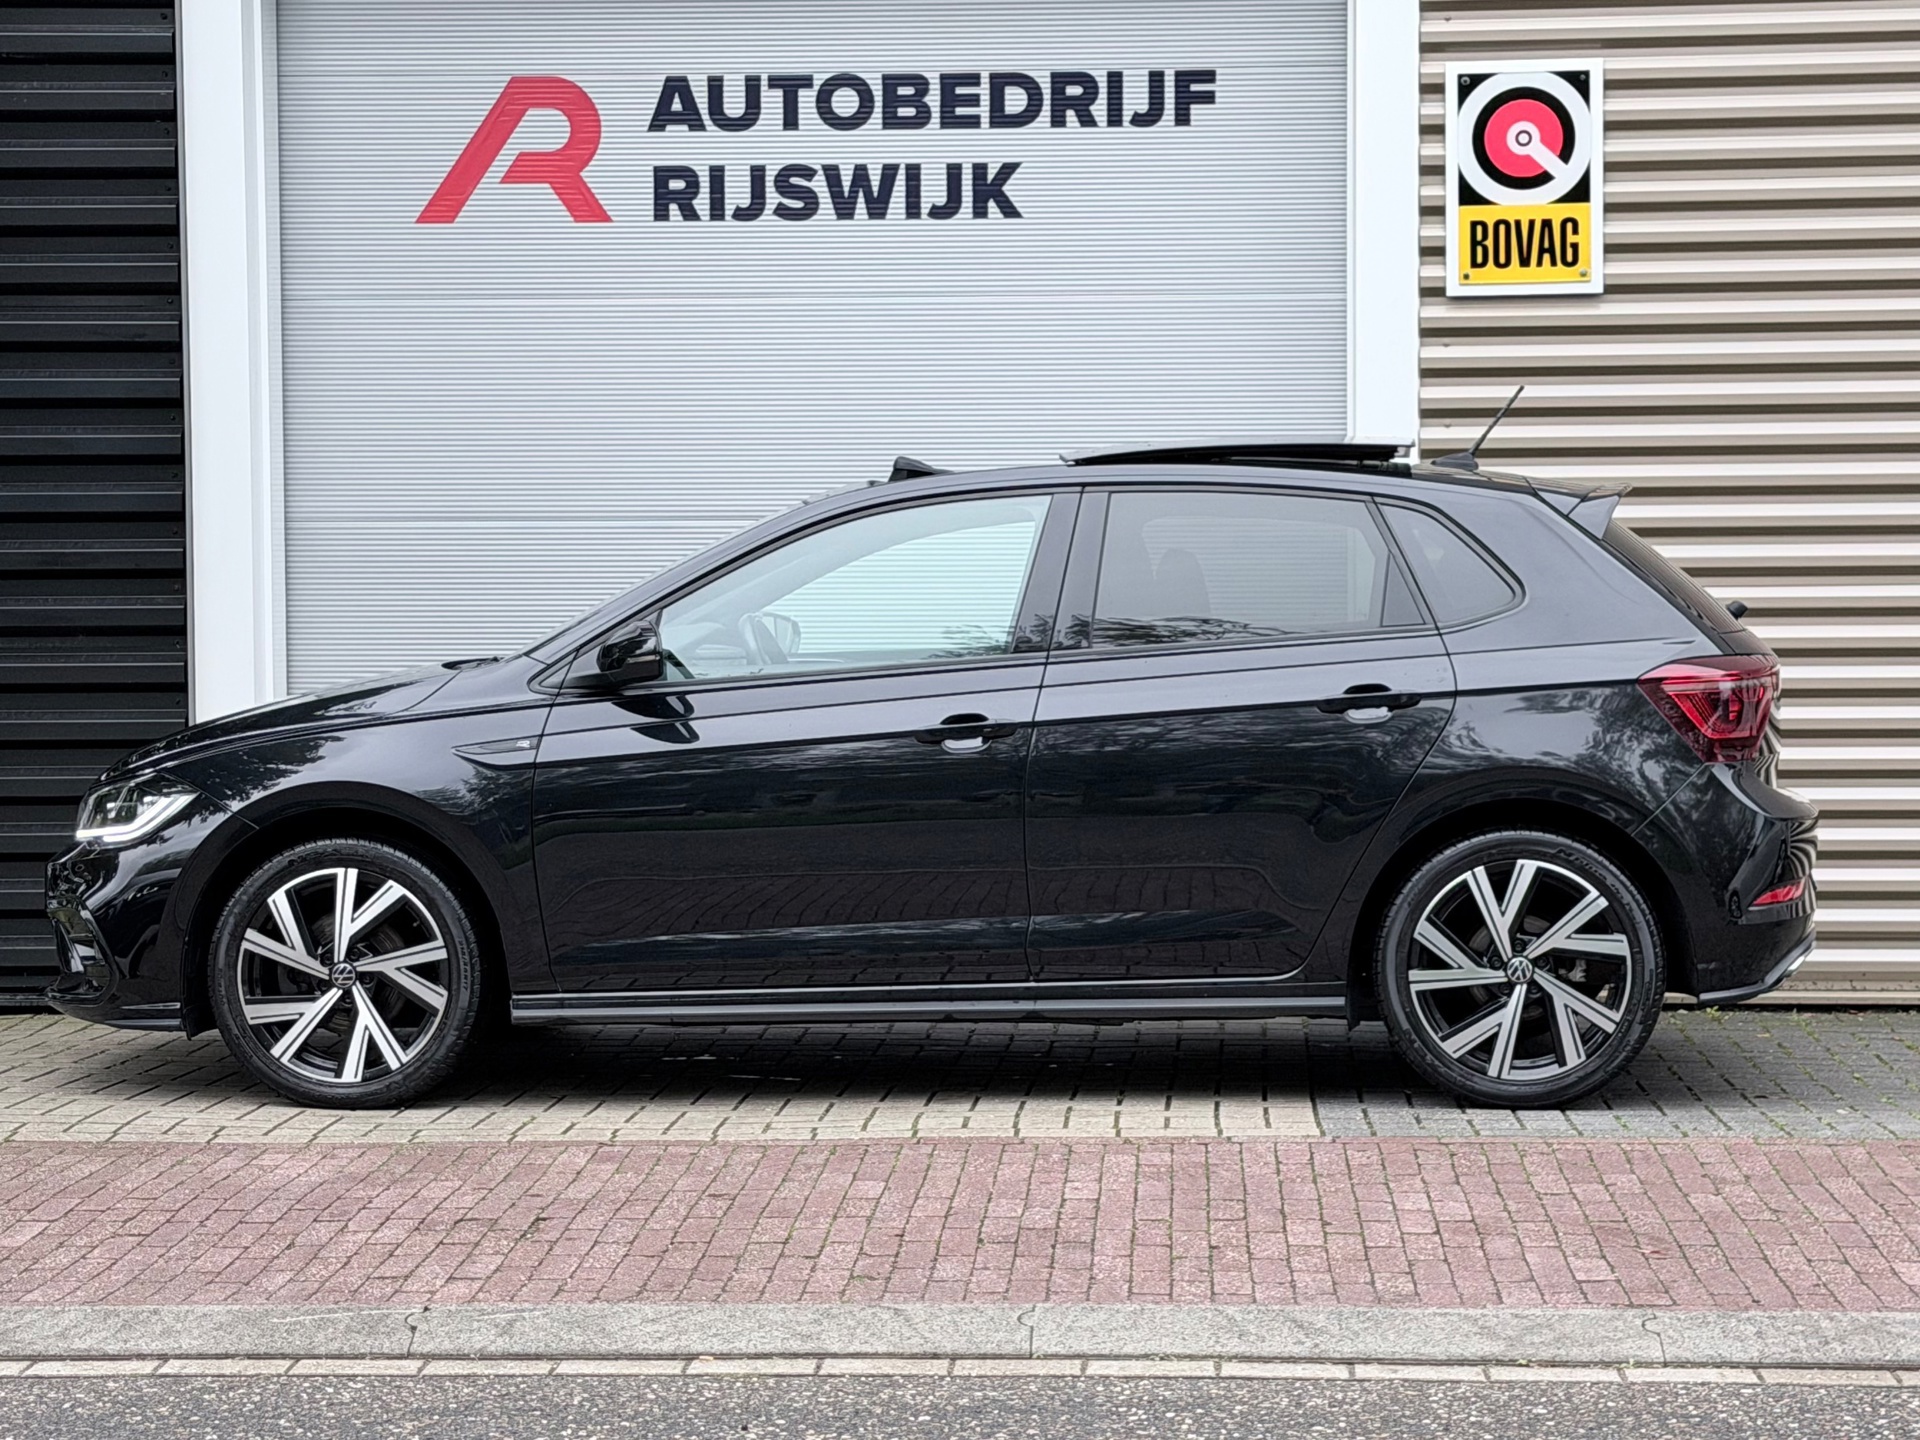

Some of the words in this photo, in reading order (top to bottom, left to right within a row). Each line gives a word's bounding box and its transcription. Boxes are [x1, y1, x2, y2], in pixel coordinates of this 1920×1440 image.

[647, 69, 1217, 132] AUTOBEDRIJF
[653, 162, 1023, 222] RIJSWIJK
[1469, 217, 1580, 269] BOVAG
